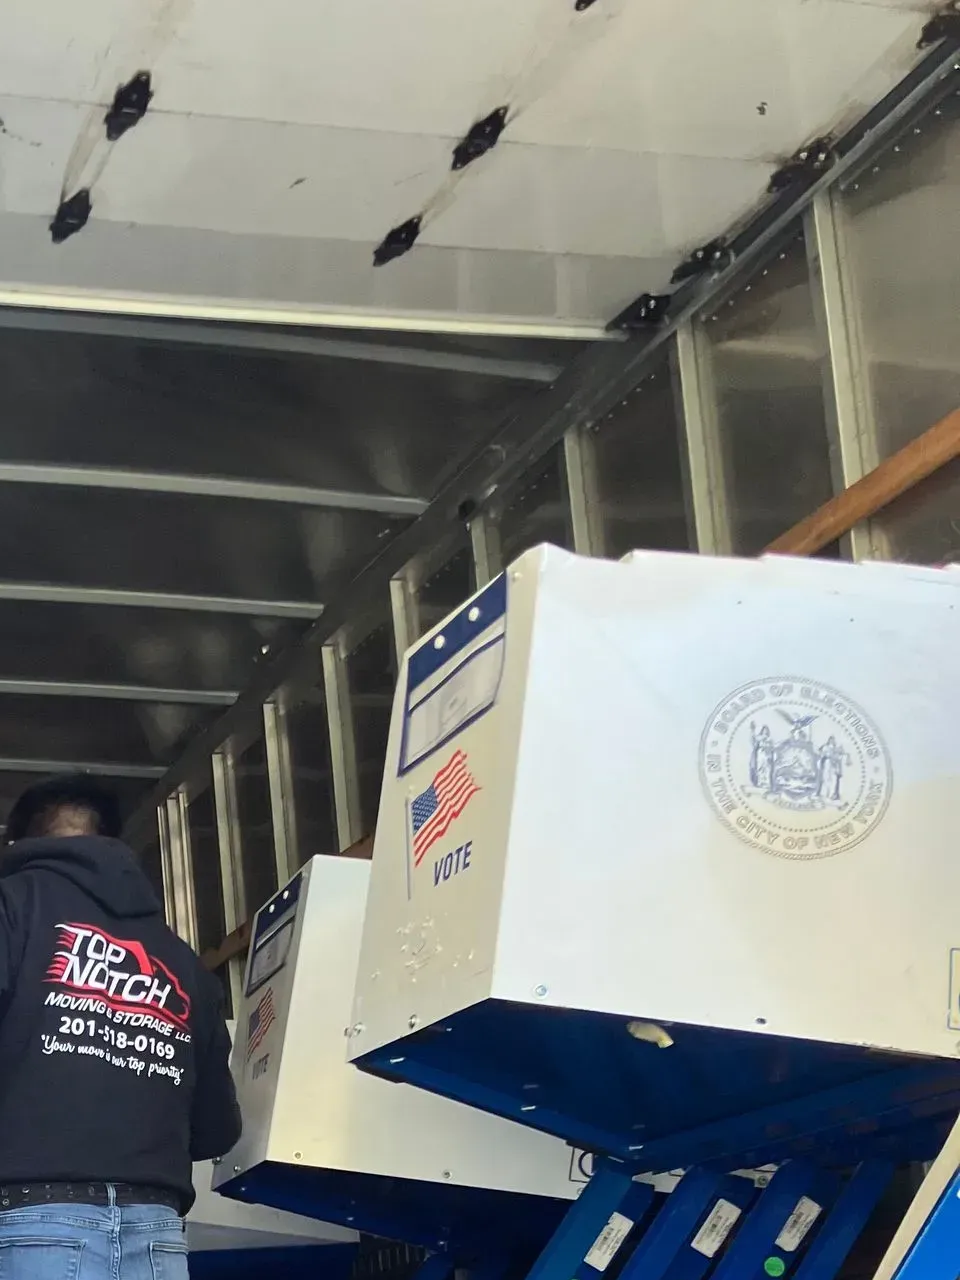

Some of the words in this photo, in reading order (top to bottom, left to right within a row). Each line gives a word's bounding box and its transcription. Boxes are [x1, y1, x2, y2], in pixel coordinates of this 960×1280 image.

[714, 687, 766, 735] BOARD
[769, 684, 794, 698] OF
[800, 685, 881, 760] ELECTIONS
[707, 753, 722, 774] IN
[711, 776, 739, 815] THE
[852, 778, 884, 825] YORK
[736, 815, 780, 846] CITY
[783, 836, 810, 851] OF
[814, 821, 856, 849] NEW
[434, 840, 473, 887] VOTE
[54, 923, 127, 966] TOP
[54, 951, 173, 1009] NOTCH
[44, 991, 106, 1014] MOVING
[106, 1007, 113, 1019] &
[113, 1010, 175, 1037] STORAGE
[174, 1031, 192, 1043] LLC
[58, 1016, 176, 1060] 201-518-0169
[127, 1055, 146, 1076] top
